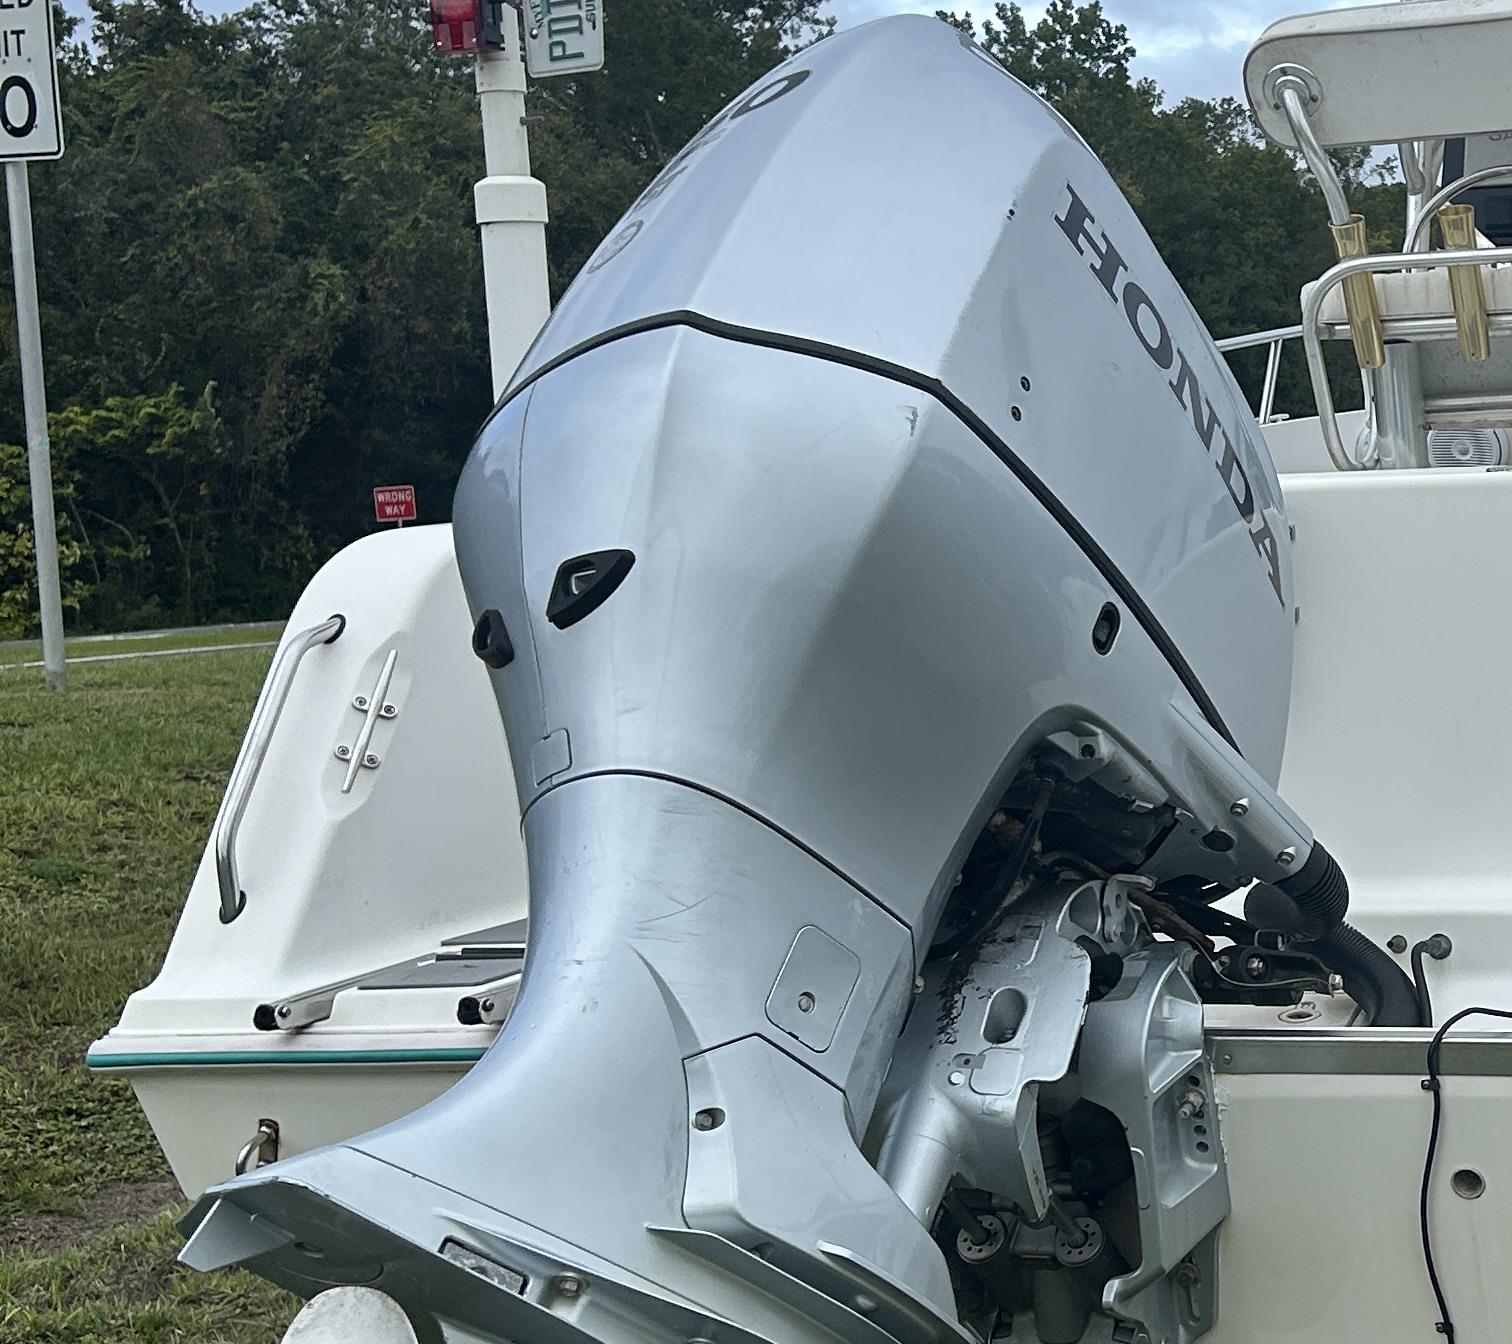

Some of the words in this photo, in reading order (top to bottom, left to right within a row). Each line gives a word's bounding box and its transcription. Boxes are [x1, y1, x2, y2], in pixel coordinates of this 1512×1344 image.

[0, 75, 37, 138] 0
[1053, 181, 1286, 609] HONDA
[377, 490, 412, 503] WRONG
[384, 503, 406, 516] WAY
